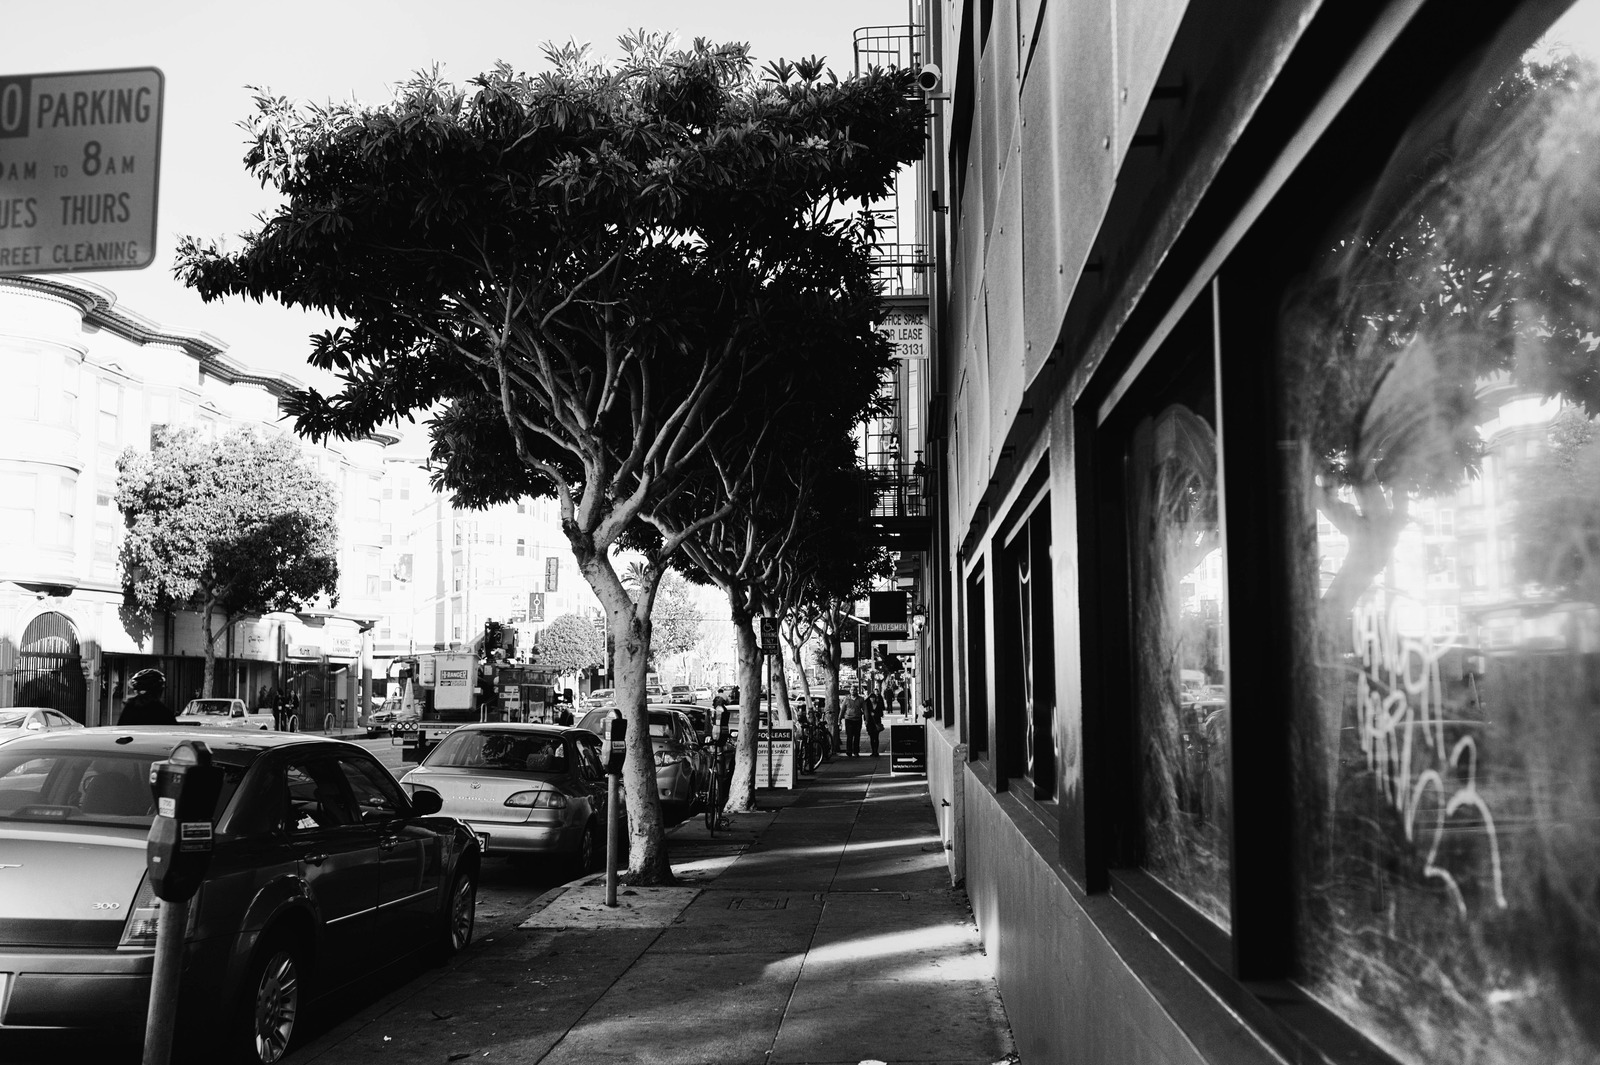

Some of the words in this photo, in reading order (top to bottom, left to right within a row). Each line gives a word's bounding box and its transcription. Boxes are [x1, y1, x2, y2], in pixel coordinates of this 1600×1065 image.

[37, 86, 151, 129] PARKING
[0, 161, 37, 181] AM
[54, 165, 69, 178] TO
[60, 191, 131, 226] THURS
[53, 240, 139, 265] CLEANING
[903, 313, 924, 326] SPACE
[898, 328, 923, 340] LEASE
[91, 901, 120, 910] 300
